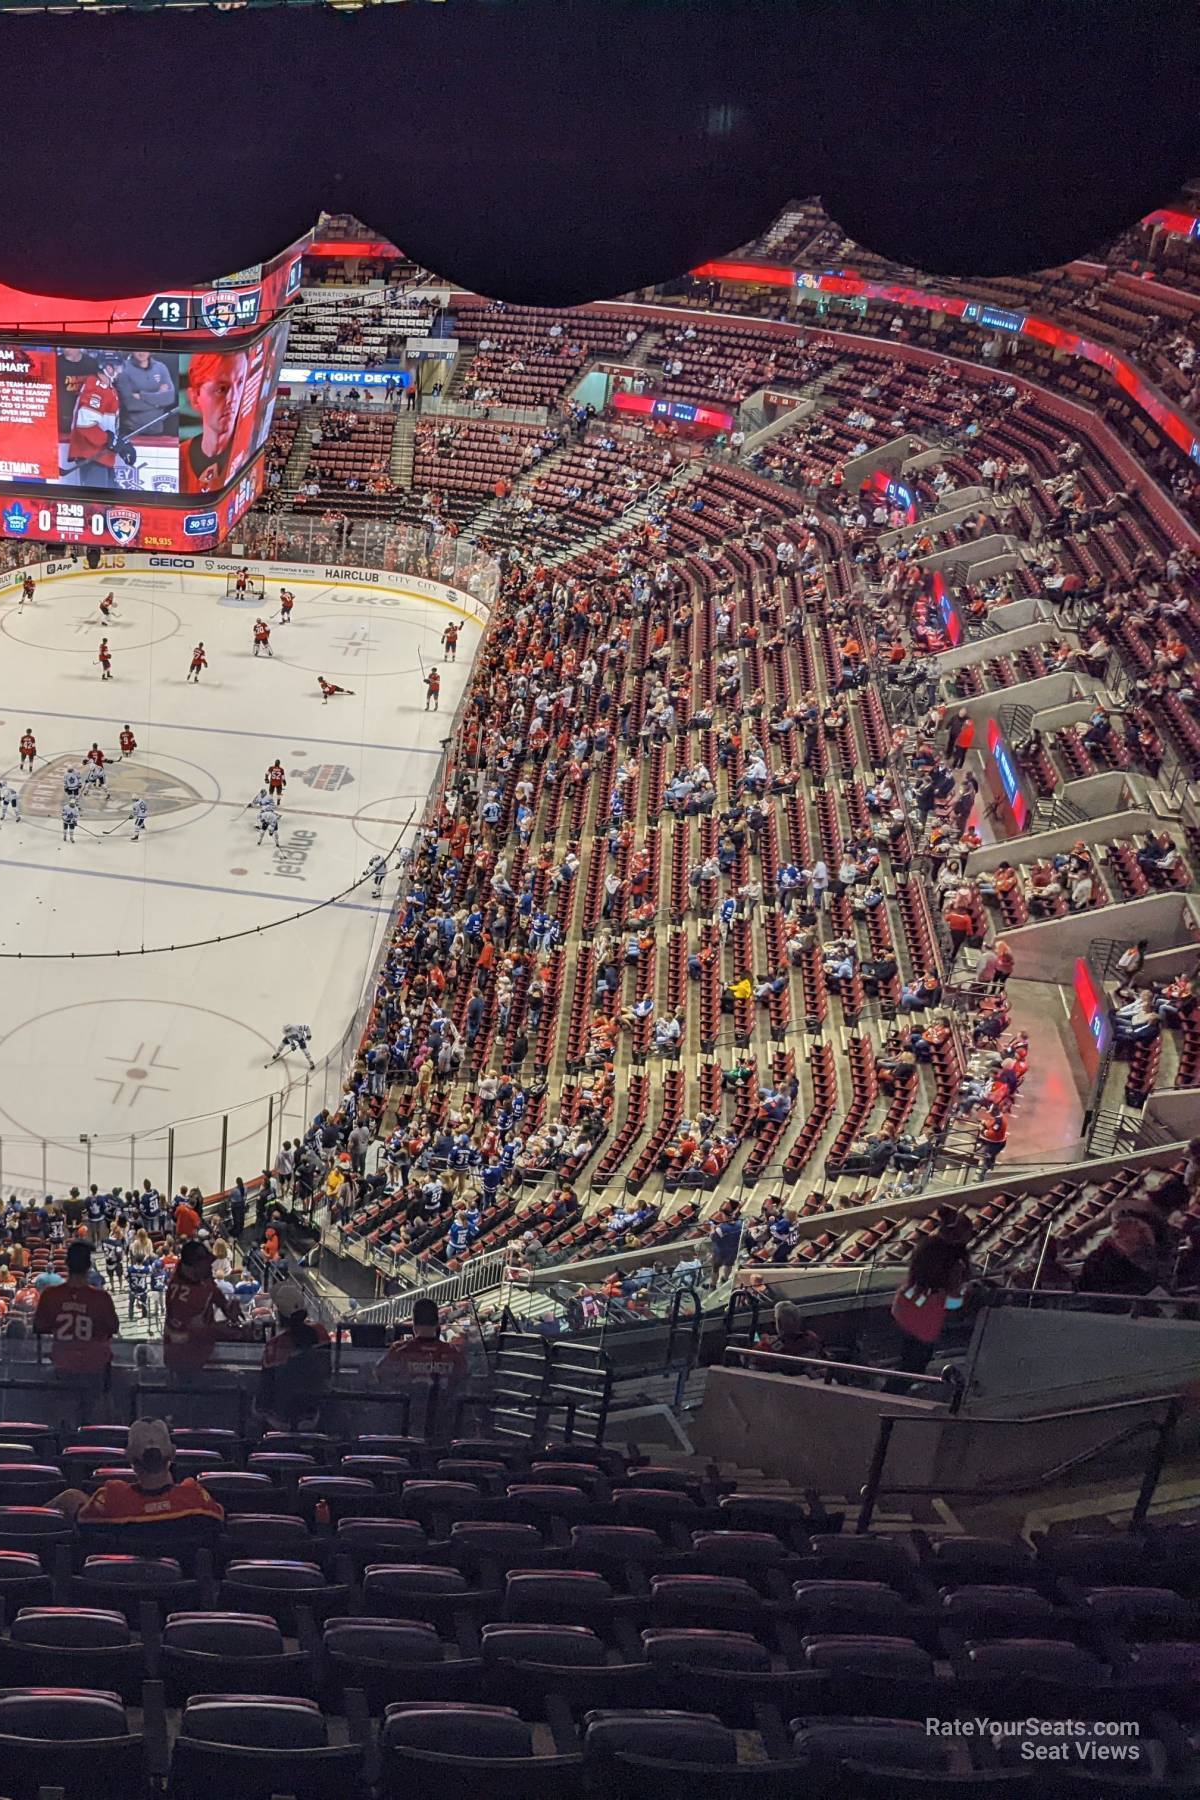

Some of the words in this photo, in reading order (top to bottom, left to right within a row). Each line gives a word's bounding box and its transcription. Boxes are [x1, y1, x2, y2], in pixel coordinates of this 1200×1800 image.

[159, 302, 180, 322] 13
[57, 503, 84, 517] 13:49
[39, 510, 51, 532] 0
[91, 514, 104, 536] 0
[149, 557, 195, 568] GEICO
[325, 569, 380, 582] HAIRCLUB
[264, 829, 318, 882] jetBlue
[56, 1313, 92, 1341] 28
